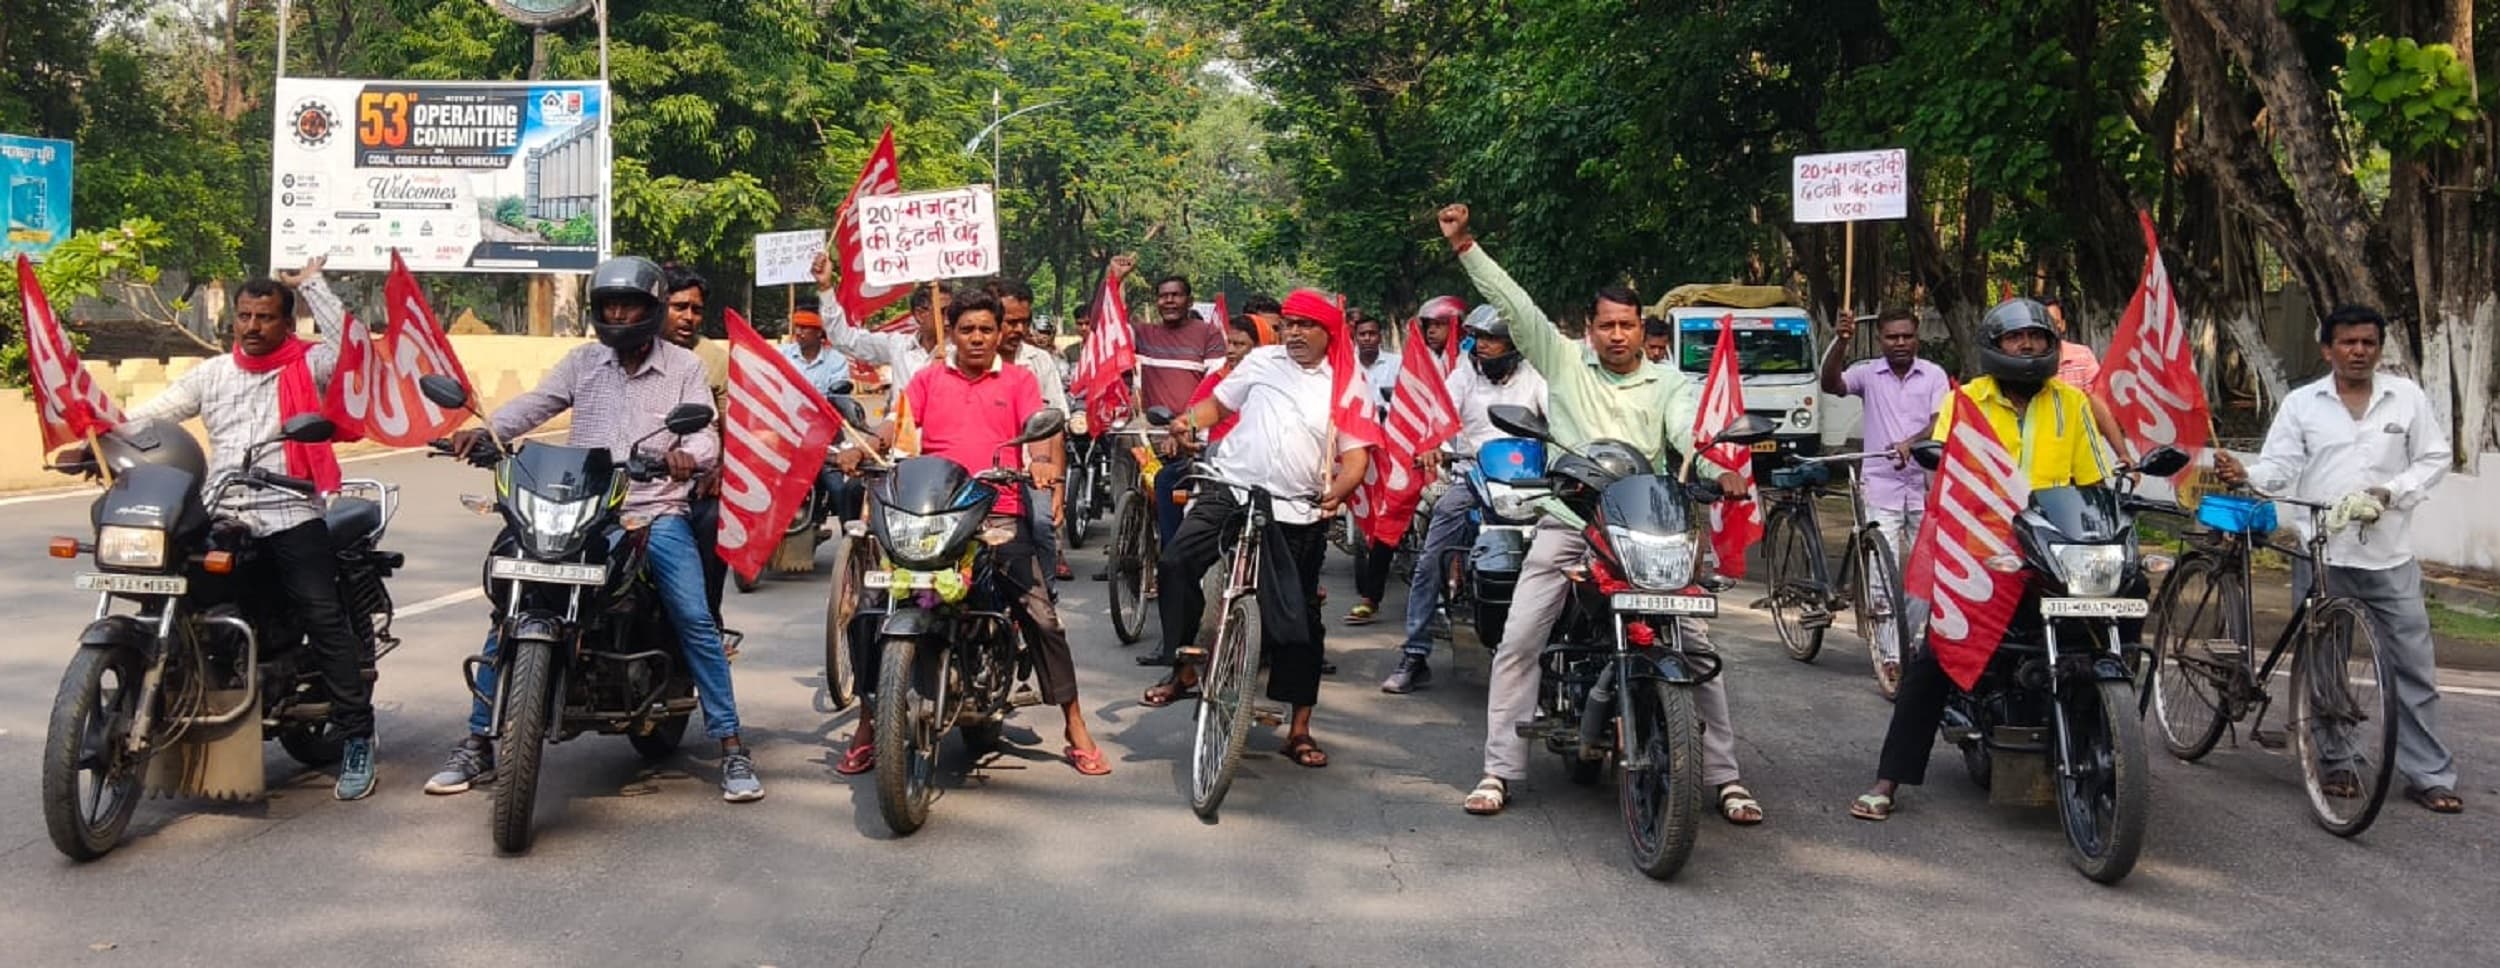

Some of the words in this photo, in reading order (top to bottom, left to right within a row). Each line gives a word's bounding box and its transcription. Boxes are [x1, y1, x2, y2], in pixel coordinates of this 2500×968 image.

[414, 105, 518, 126] OPERATING
[413, 127, 518, 147] COMMITTEE
[454, 156, 506, 166] CHEMICALS
